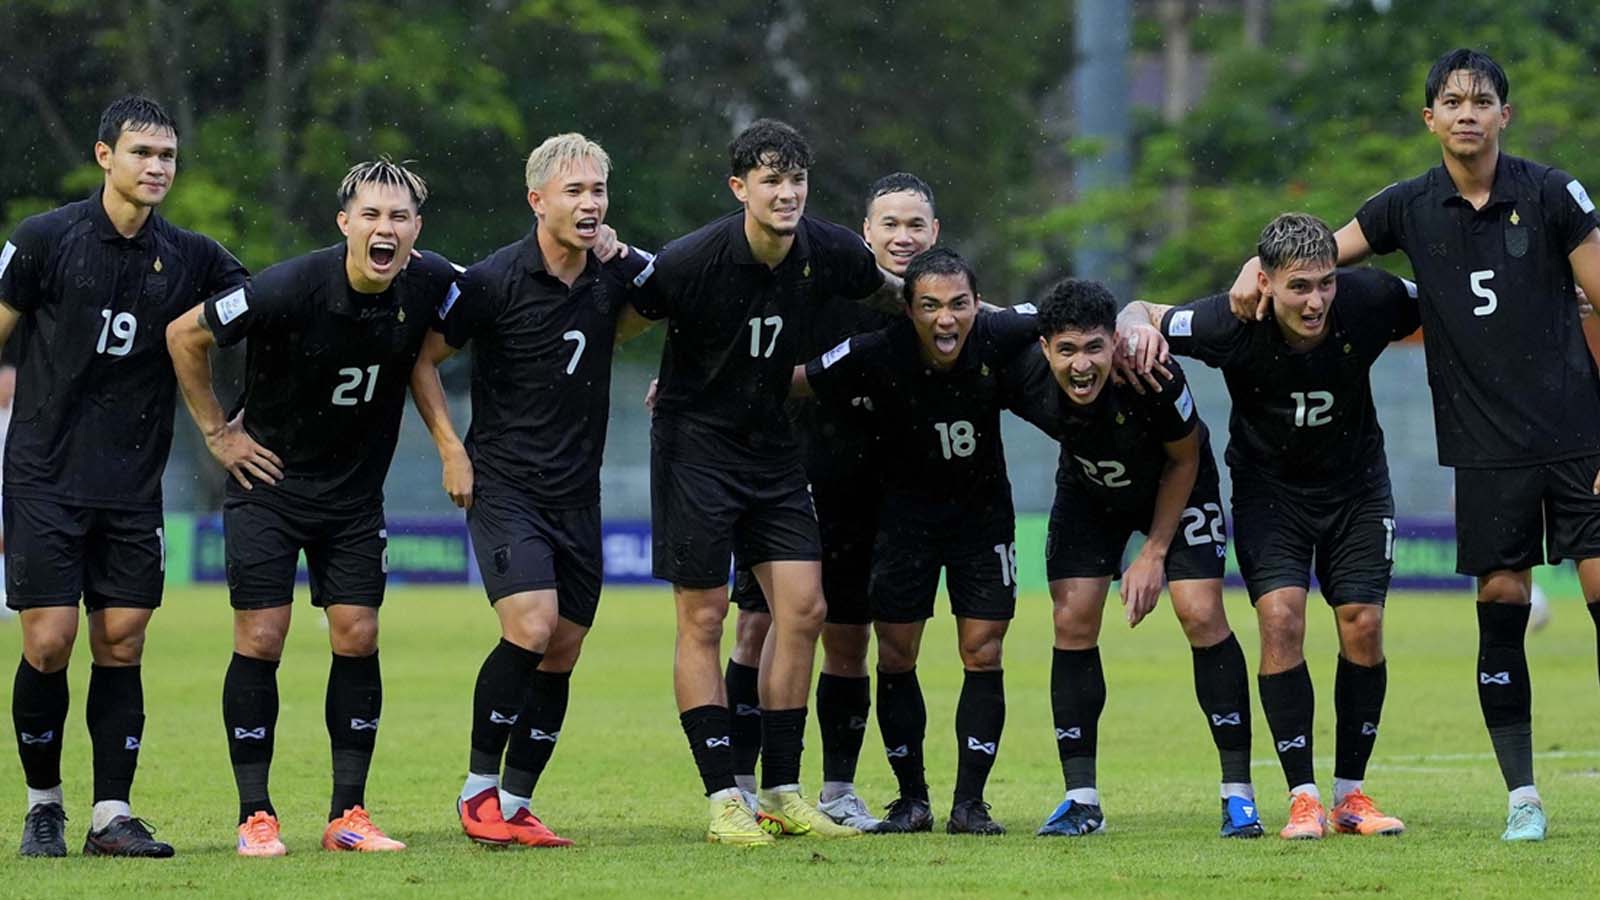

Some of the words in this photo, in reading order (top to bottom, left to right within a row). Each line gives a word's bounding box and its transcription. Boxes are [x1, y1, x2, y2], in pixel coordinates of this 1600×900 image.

[1470, 270, 1497, 316] 5
[96, 309, 137, 356] 19
[563, 330, 586, 375] 7
[748, 315, 783, 358] 17
[331, 364, 380, 406] 21
[1290, 391, 1334, 427] 12
[934, 420, 976, 460] 18
[1073, 454, 1132, 488] 22
[1181, 502, 1226, 546] 22
